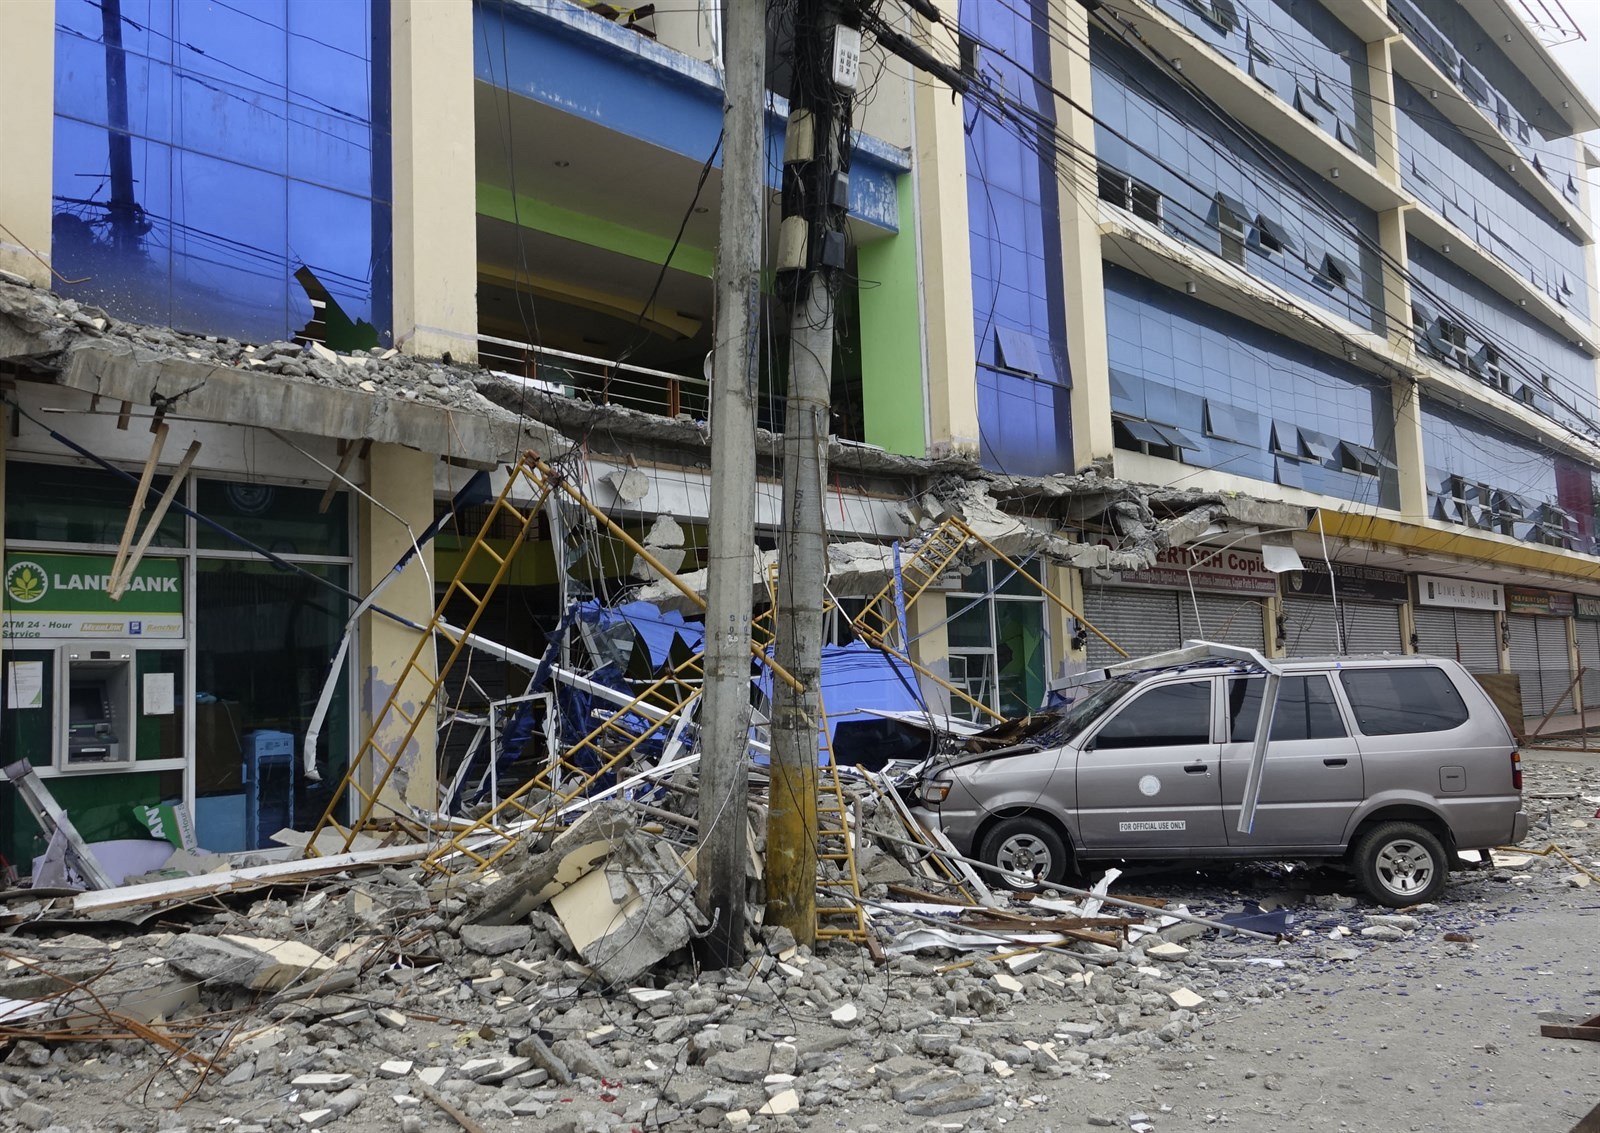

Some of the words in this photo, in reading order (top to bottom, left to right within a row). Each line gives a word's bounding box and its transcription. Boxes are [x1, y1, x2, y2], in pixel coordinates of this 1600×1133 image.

[1156, 545, 1223, 569] ERTECH
[1228, 553, 1276, 576] Copie
[2, 621, 24, 629] ATM
[49, 621, 72, 629] Hour
[2, 630, 41, 638] Service
[144, 805, 167, 839] AN
[1132, 822, 1157, 830] OFFICIAL
[1170, 821, 1185, 829] ONLY
